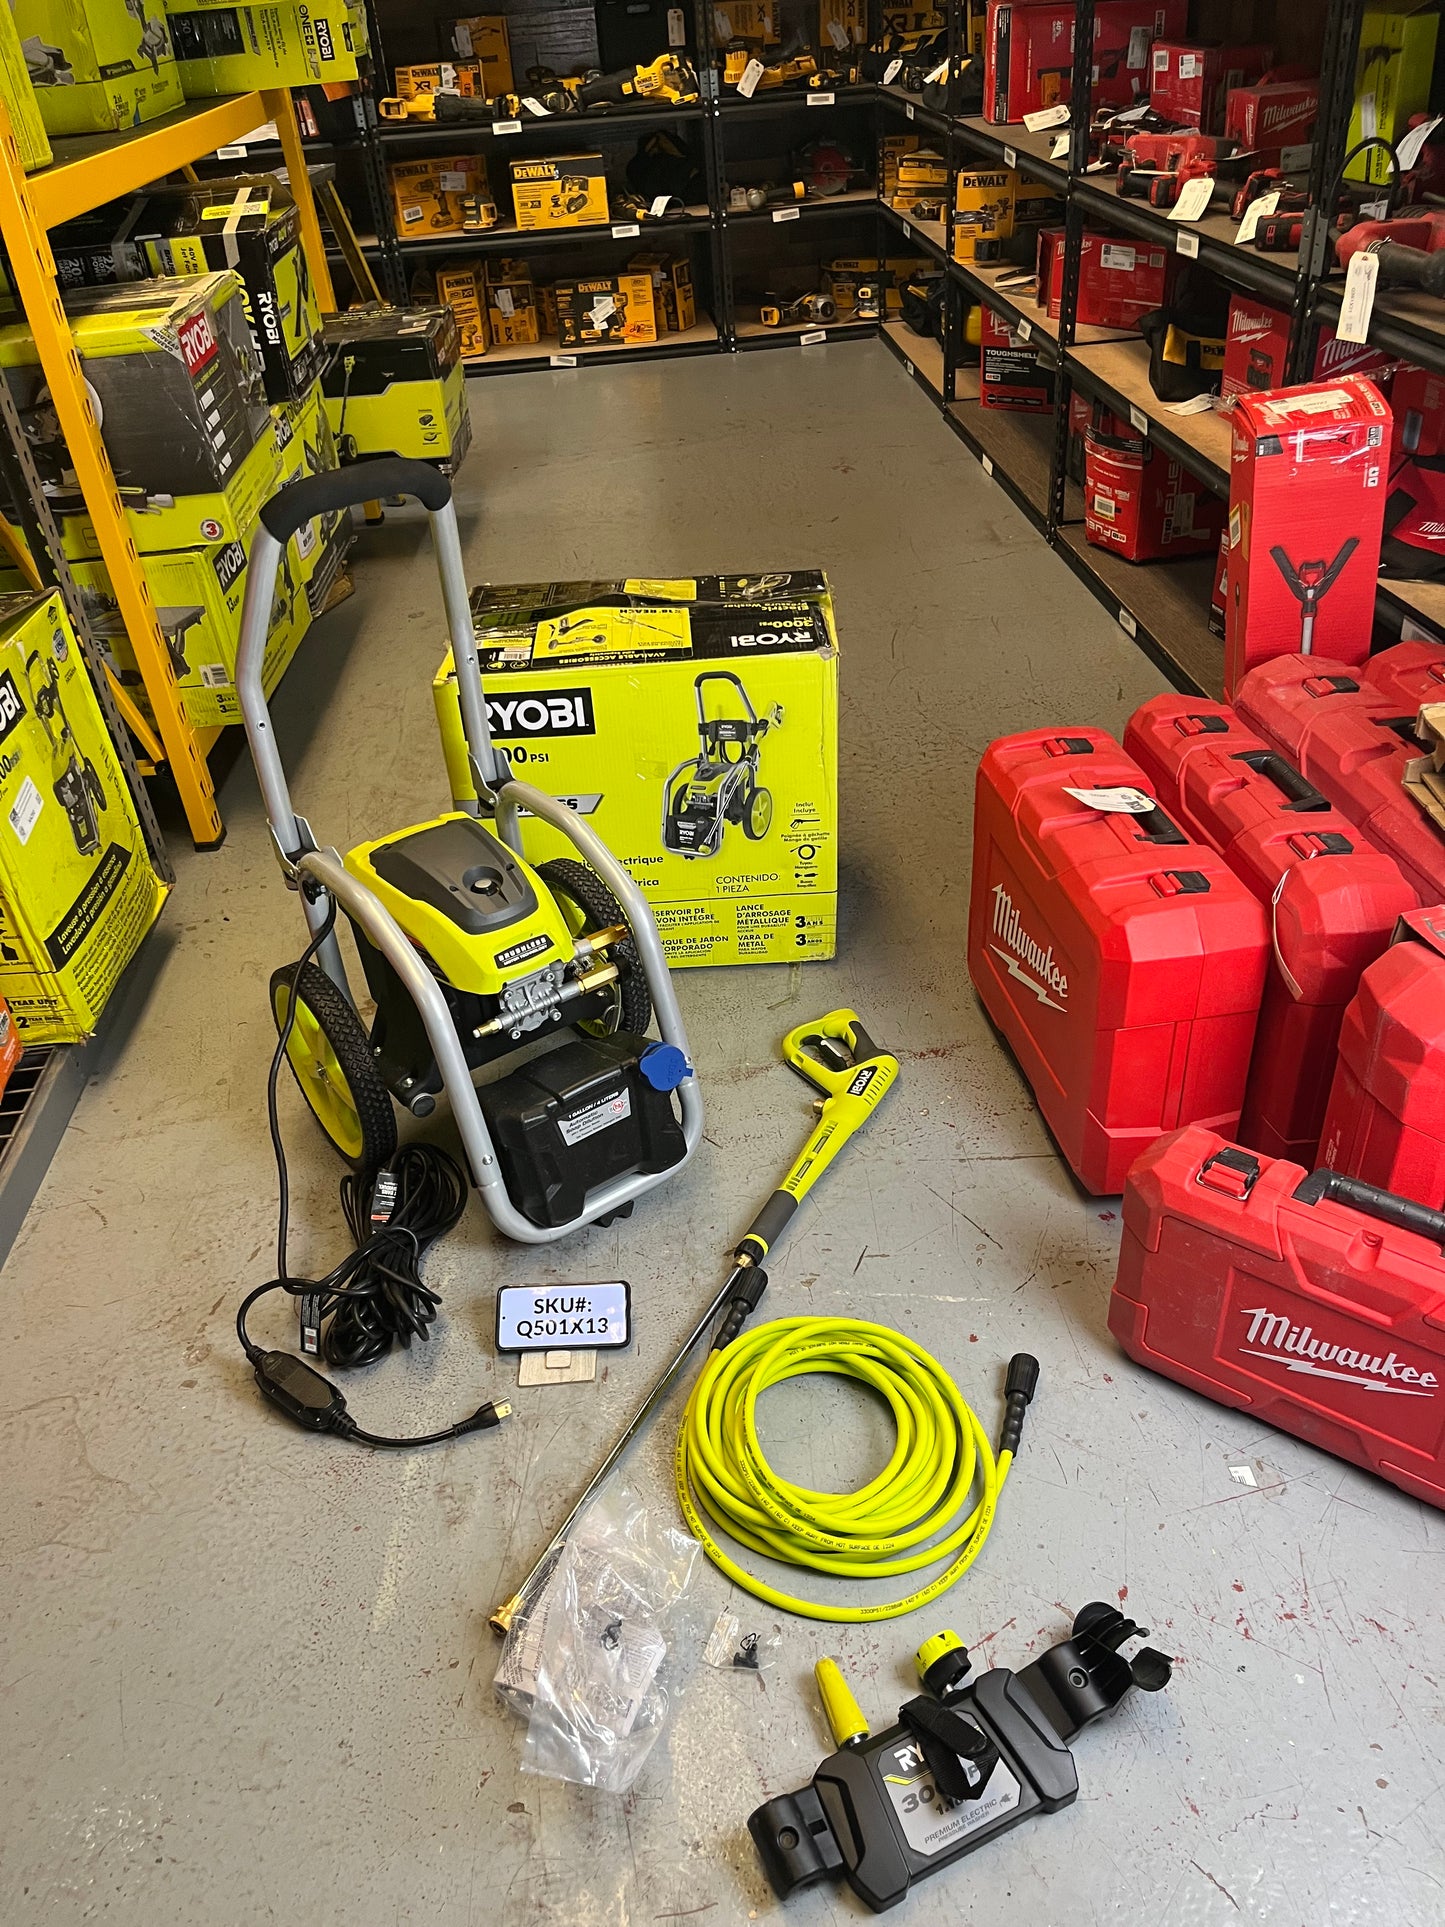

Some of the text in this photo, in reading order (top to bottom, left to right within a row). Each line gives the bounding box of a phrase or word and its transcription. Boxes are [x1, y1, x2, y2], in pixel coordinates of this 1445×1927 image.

[315, 20, 333, 60] RYOBI
[414, 81, 431, 91] XR
[395, 164, 428, 177] DEWALT
[514, 164, 556, 179] DEWALT
[963, 176, 1008, 187] DEWALT
[578, 281, 612, 293] DEWALT
[257, 291, 280, 344] RYOBI
[1231, 308, 1273, 333] Milwaukee
[181, 314, 216, 366] RYOBI
[986, 350, 1037, 359] TOUGHSHELL
[206, 523, 217, 537] 3
[216, 542, 246, 588] RYOBI
[772, 618, 814, 629] 3000
[731, 631, 815, 648] RYOBI
[558, 651, 666, 664] AVAILABLE ACCESSORIES
[530, 753, 549, 763] PSI
[618, 855, 663, 865] ectrique
[715, 872, 781, 885] CONTENIDO:
[716, 883, 750, 893] 1 PIEZA
[57, 915, 79, 945] Laveuse
[81, 883, 100, 914] pression
[653, 908, 693, 917] SERVOIR
[736, 904, 764, 912] LANCE
[736, 910, 792, 919] D'ARROSAGE
[737, 916, 790, 926] MÉTALLIQUE
[795, 915, 806, 928] 3
[61, 920, 87, 955] Lavadora
[700, 934, 729, 943] JABÓN
[795, 933, 806, 946] 3
[992, 883, 1068, 998] Milwaukee
[664, 943, 713, 952] ORPORADO
[11, 999, 35, 1008] YEAR
[16, 1017, 29, 1029] 2
[850, 1070, 873, 1094] RYOBI
[572, 1103, 593, 1119] GALLON
[601, 1091, 619, 1103] LITERS
[566, 1112, 604, 1134] Soap Dilution
[569, 1110, 598, 1128] Automatic
[534, 1297, 592, 1315] SKU#:
[516, 1317, 609, 1339] Q501X13
[1240, 1307, 1439, 1388] Milwaukee
[792, 1523, 804, 1532] KEEP
[820, 1537, 834, 1545] FROM
[938, 1575, 949, 1585] KEEP
[959, 1555, 969, 1566] FROM
[974, 1526, 985, 1545] SURFACE
[924, 1797, 999, 1845] PREMIUM ELECTRIC
[966, 1810, 990, 1830] WASHER
